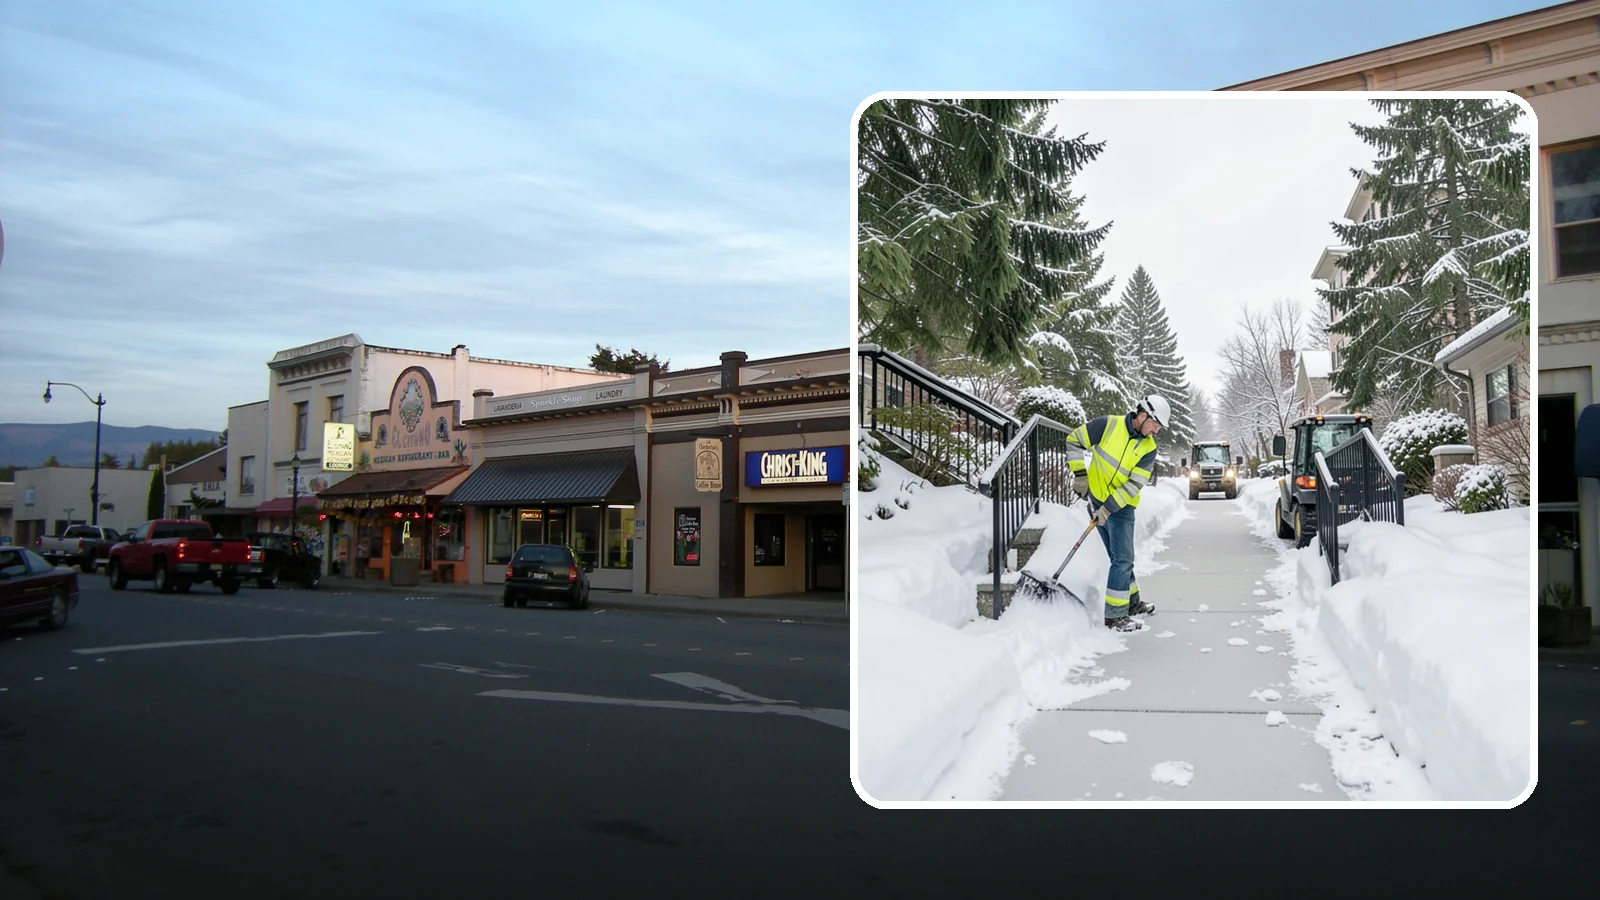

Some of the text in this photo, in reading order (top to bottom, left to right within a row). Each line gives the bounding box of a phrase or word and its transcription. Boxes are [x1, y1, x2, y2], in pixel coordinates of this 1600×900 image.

[596, 389, 623, 400] LAUNDRY
[493, 402, 522, 412] LAVANDERIA
[531, 395, 582, 408] Sparkle Shop
[373, 455, 396, 464] MEXICAN
[397, 451, 433, 462] RESTAURANT
[438, 450, 450, 459] BAR
[761, 449, 827, 478] CHRIST KING
